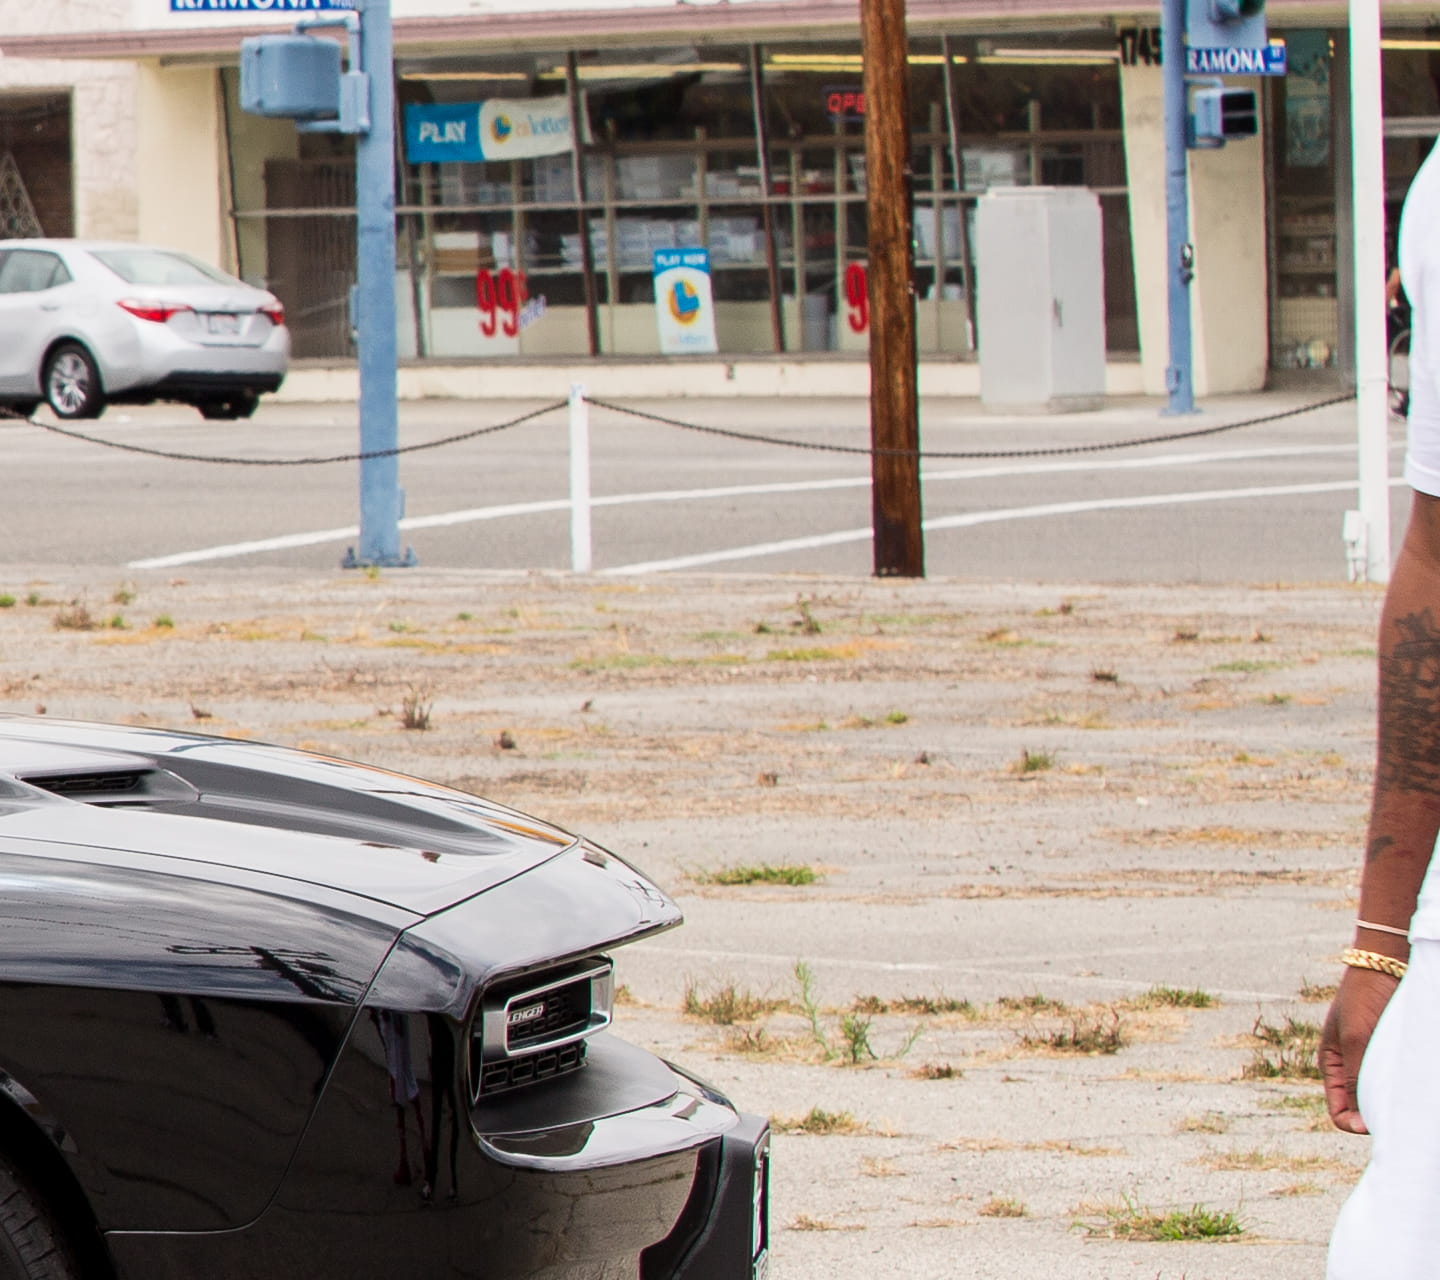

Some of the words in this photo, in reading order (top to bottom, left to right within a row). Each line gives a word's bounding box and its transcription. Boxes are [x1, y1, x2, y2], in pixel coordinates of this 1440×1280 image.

[1188, 48, 1266, 72] RAMONA
[828, 93, 866, 113] OPE
[419, 121, 466, 144] PLAY
